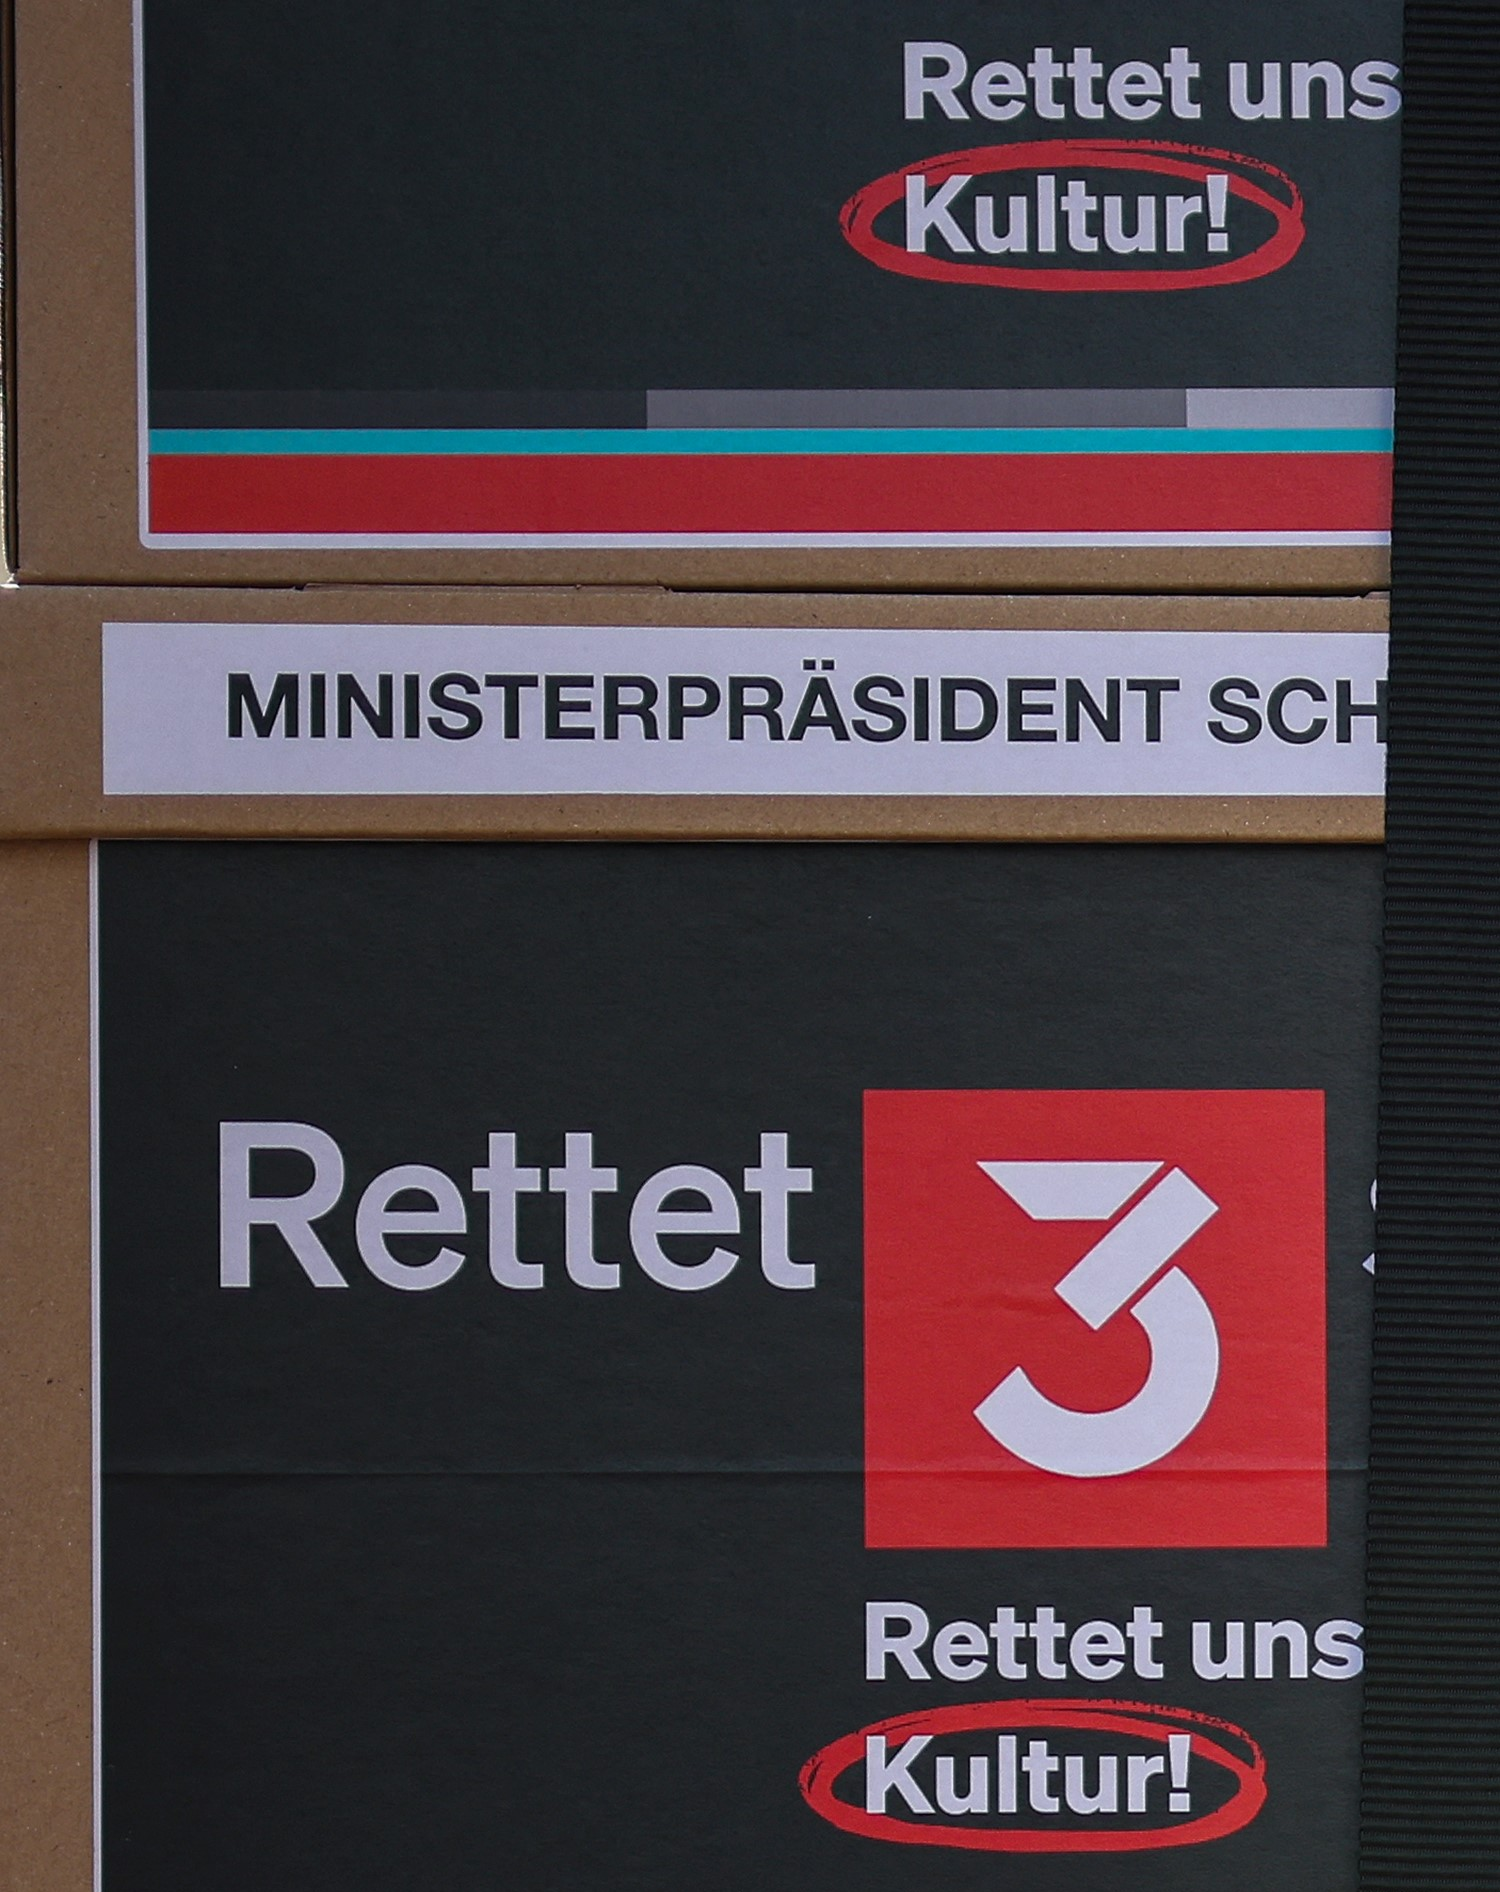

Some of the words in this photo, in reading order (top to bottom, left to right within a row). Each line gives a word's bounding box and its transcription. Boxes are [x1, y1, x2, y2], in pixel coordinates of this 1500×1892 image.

[903, 40, 1203, 122] Rettet
[1228, 59, 1403, 122] uns
[904, 173, 1230, 255] Kultur!
[226, 658, 1181, 744] MINISTERPRÄSIDENT
[218, 1120, 817, 1292] Rettet
[972, 1159, 1221, 1479] 3
[864, 1600, 1165, 1682] Rettet
[1191, 1618, 1365, 1681] uns
[865, 1733, 1192, 1816] Kultur!
